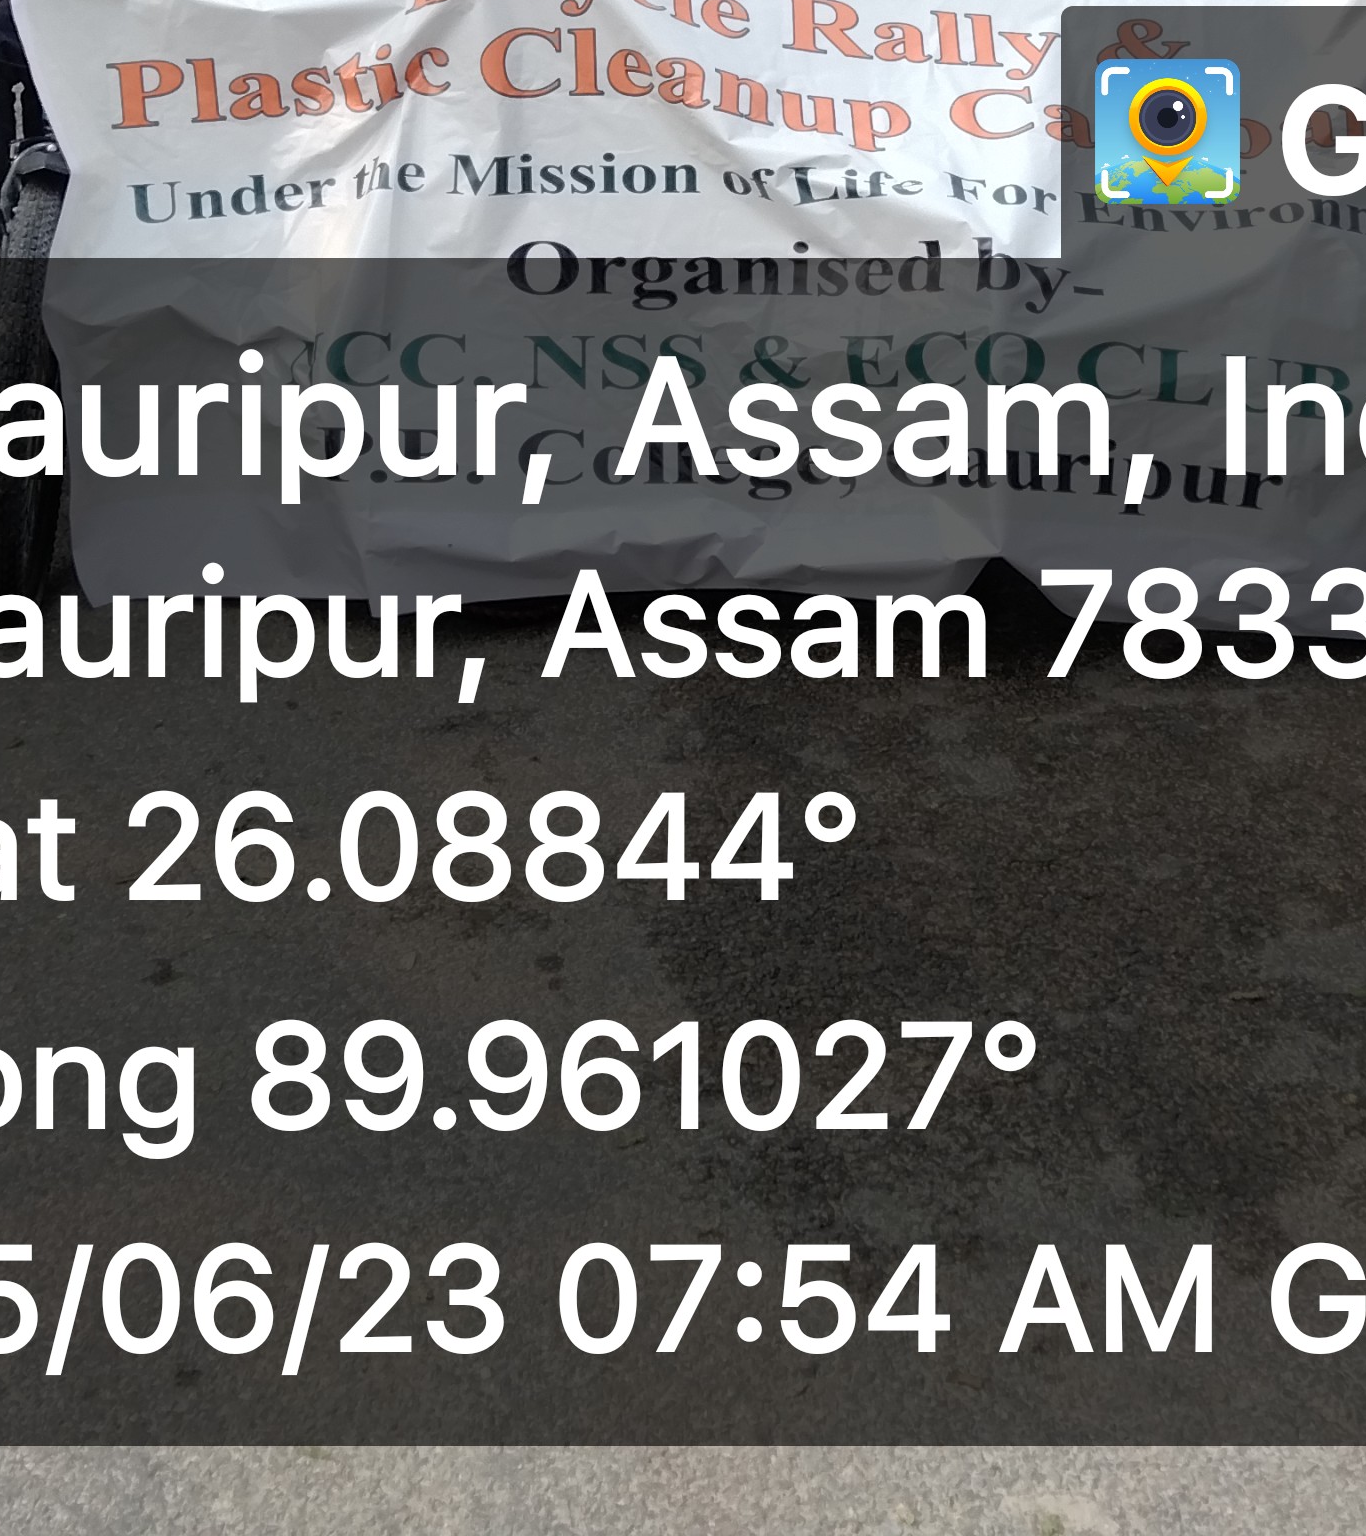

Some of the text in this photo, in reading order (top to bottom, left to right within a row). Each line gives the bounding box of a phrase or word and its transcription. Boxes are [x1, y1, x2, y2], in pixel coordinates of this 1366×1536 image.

[106, 43, 451, 130] Plastic
[479, 26, 912, 153] Cleanup
[127, 174, 336, 224] Under
[353, 156, 426, 200] the
[446, 153, 701, 197] Mission
[722, 167, 775, 201] of
[789, 165, 925, 206] Life
[942, 170, 1058, 216] For
[505, 236, 1106, 314] Organised by-
[523, 333, 707, 390] NSS
[738, 335, 812, 389] &
[839, 330, 1045, 392] ECO
[1077, 340, 1354, 421] CLUB
[885, 435, 1284, 517] Gauripur
